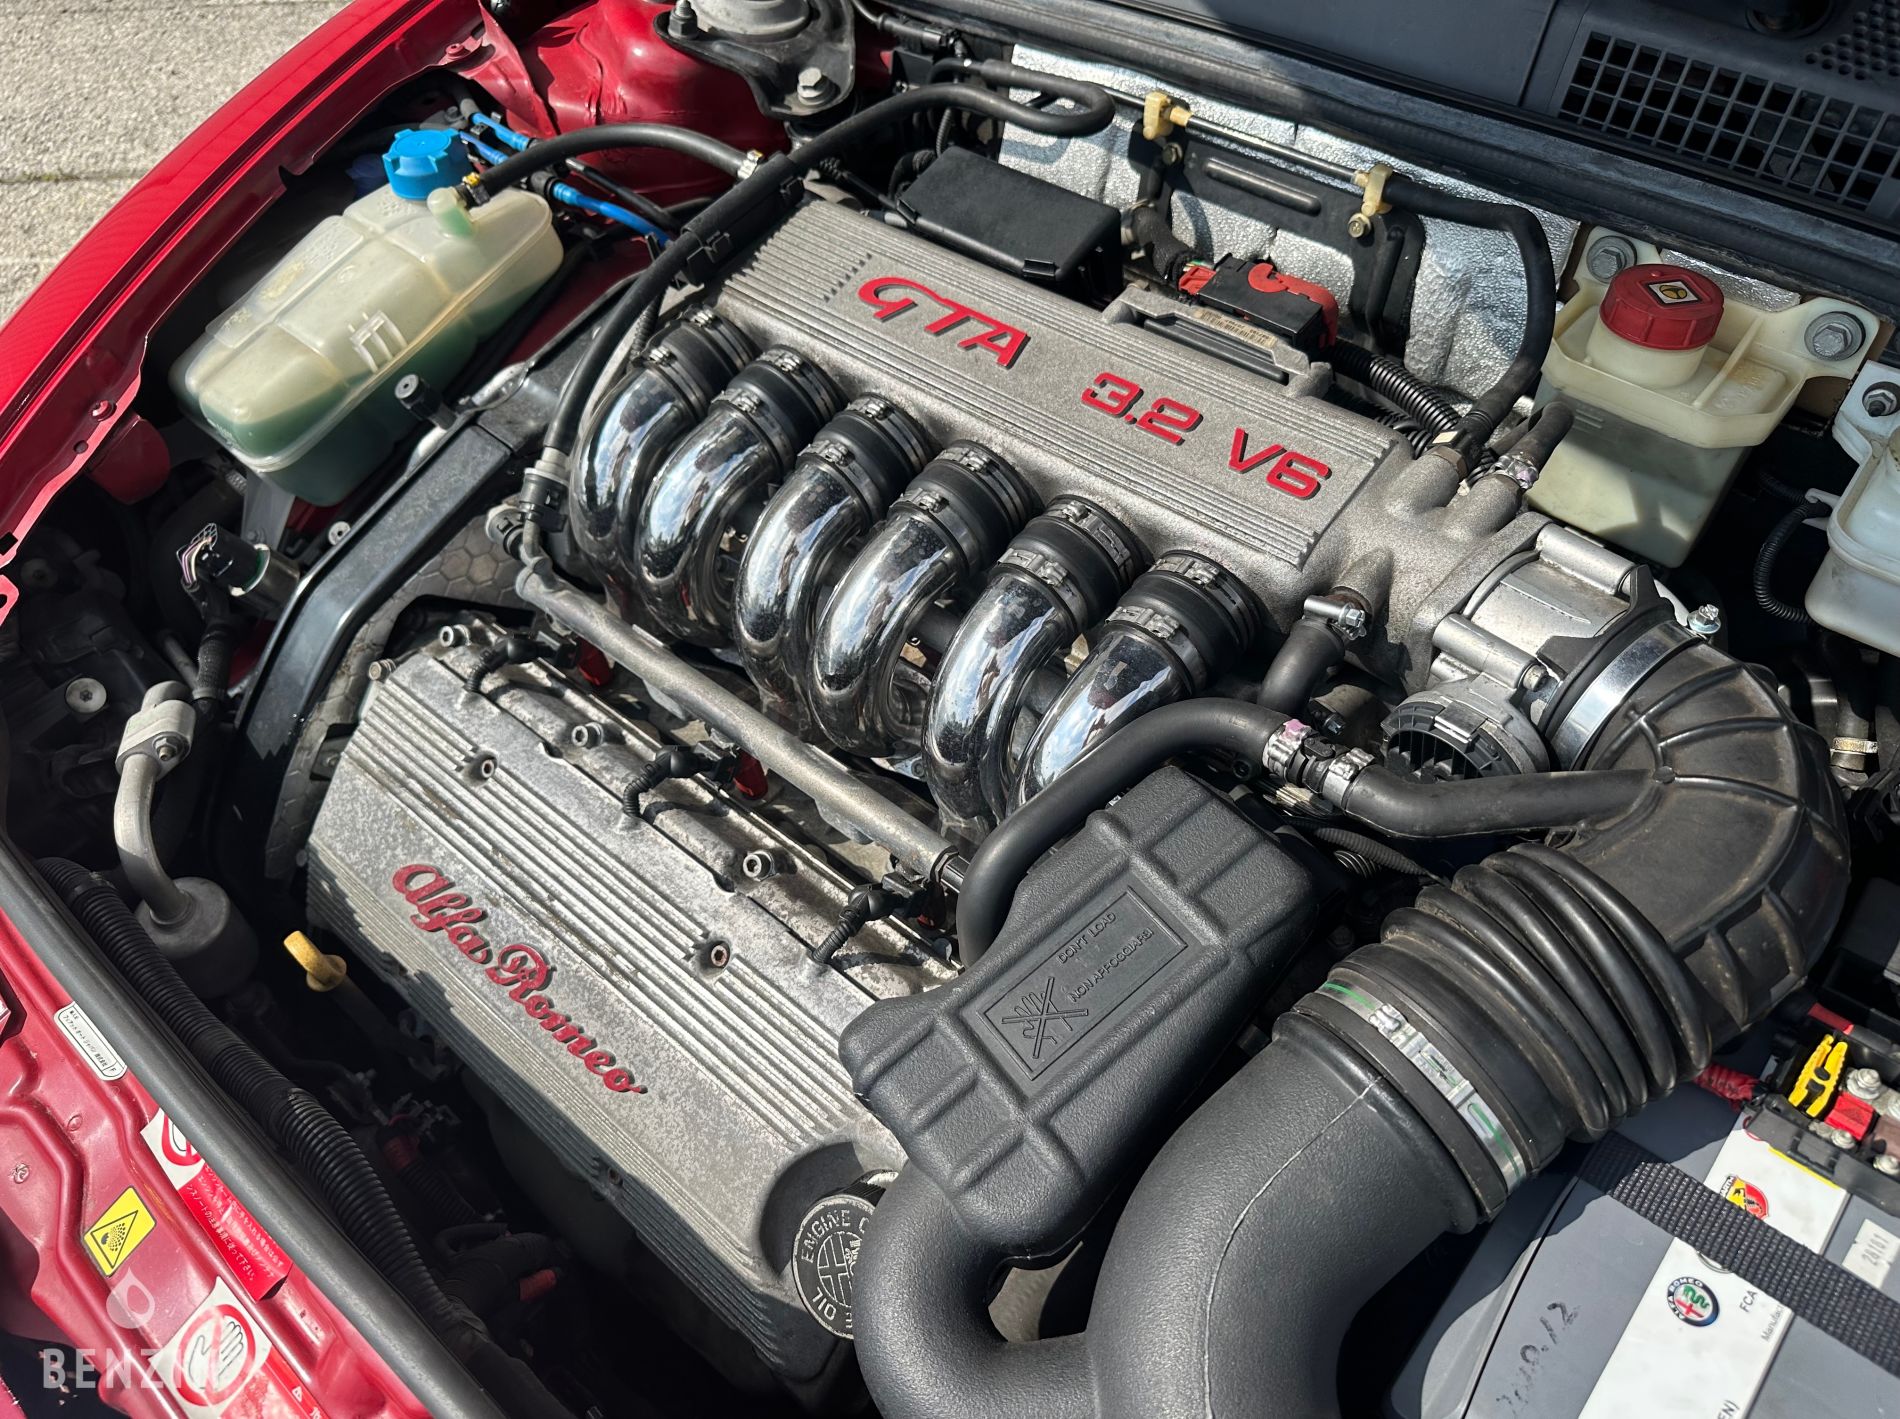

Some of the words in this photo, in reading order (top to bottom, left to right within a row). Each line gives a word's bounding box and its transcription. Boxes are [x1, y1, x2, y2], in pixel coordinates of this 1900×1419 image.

[858, 275, 1030, 369] GTA
[1081, 371, 1203, 444] 3.2
[1229, 427, 1332, 499] V6
[1089, 911, 1117, 938] LOAD
[392, 863, 493, 965] Alfa
[485, 943, 649, 1094] Romeo
[1069, 977, 1097, 1004] NON
[801, 1209, 851, 1264] ENGINE
[811, 1286, 837, 1321] OIL
[1739, 1289, 1758, 1314] FCA
